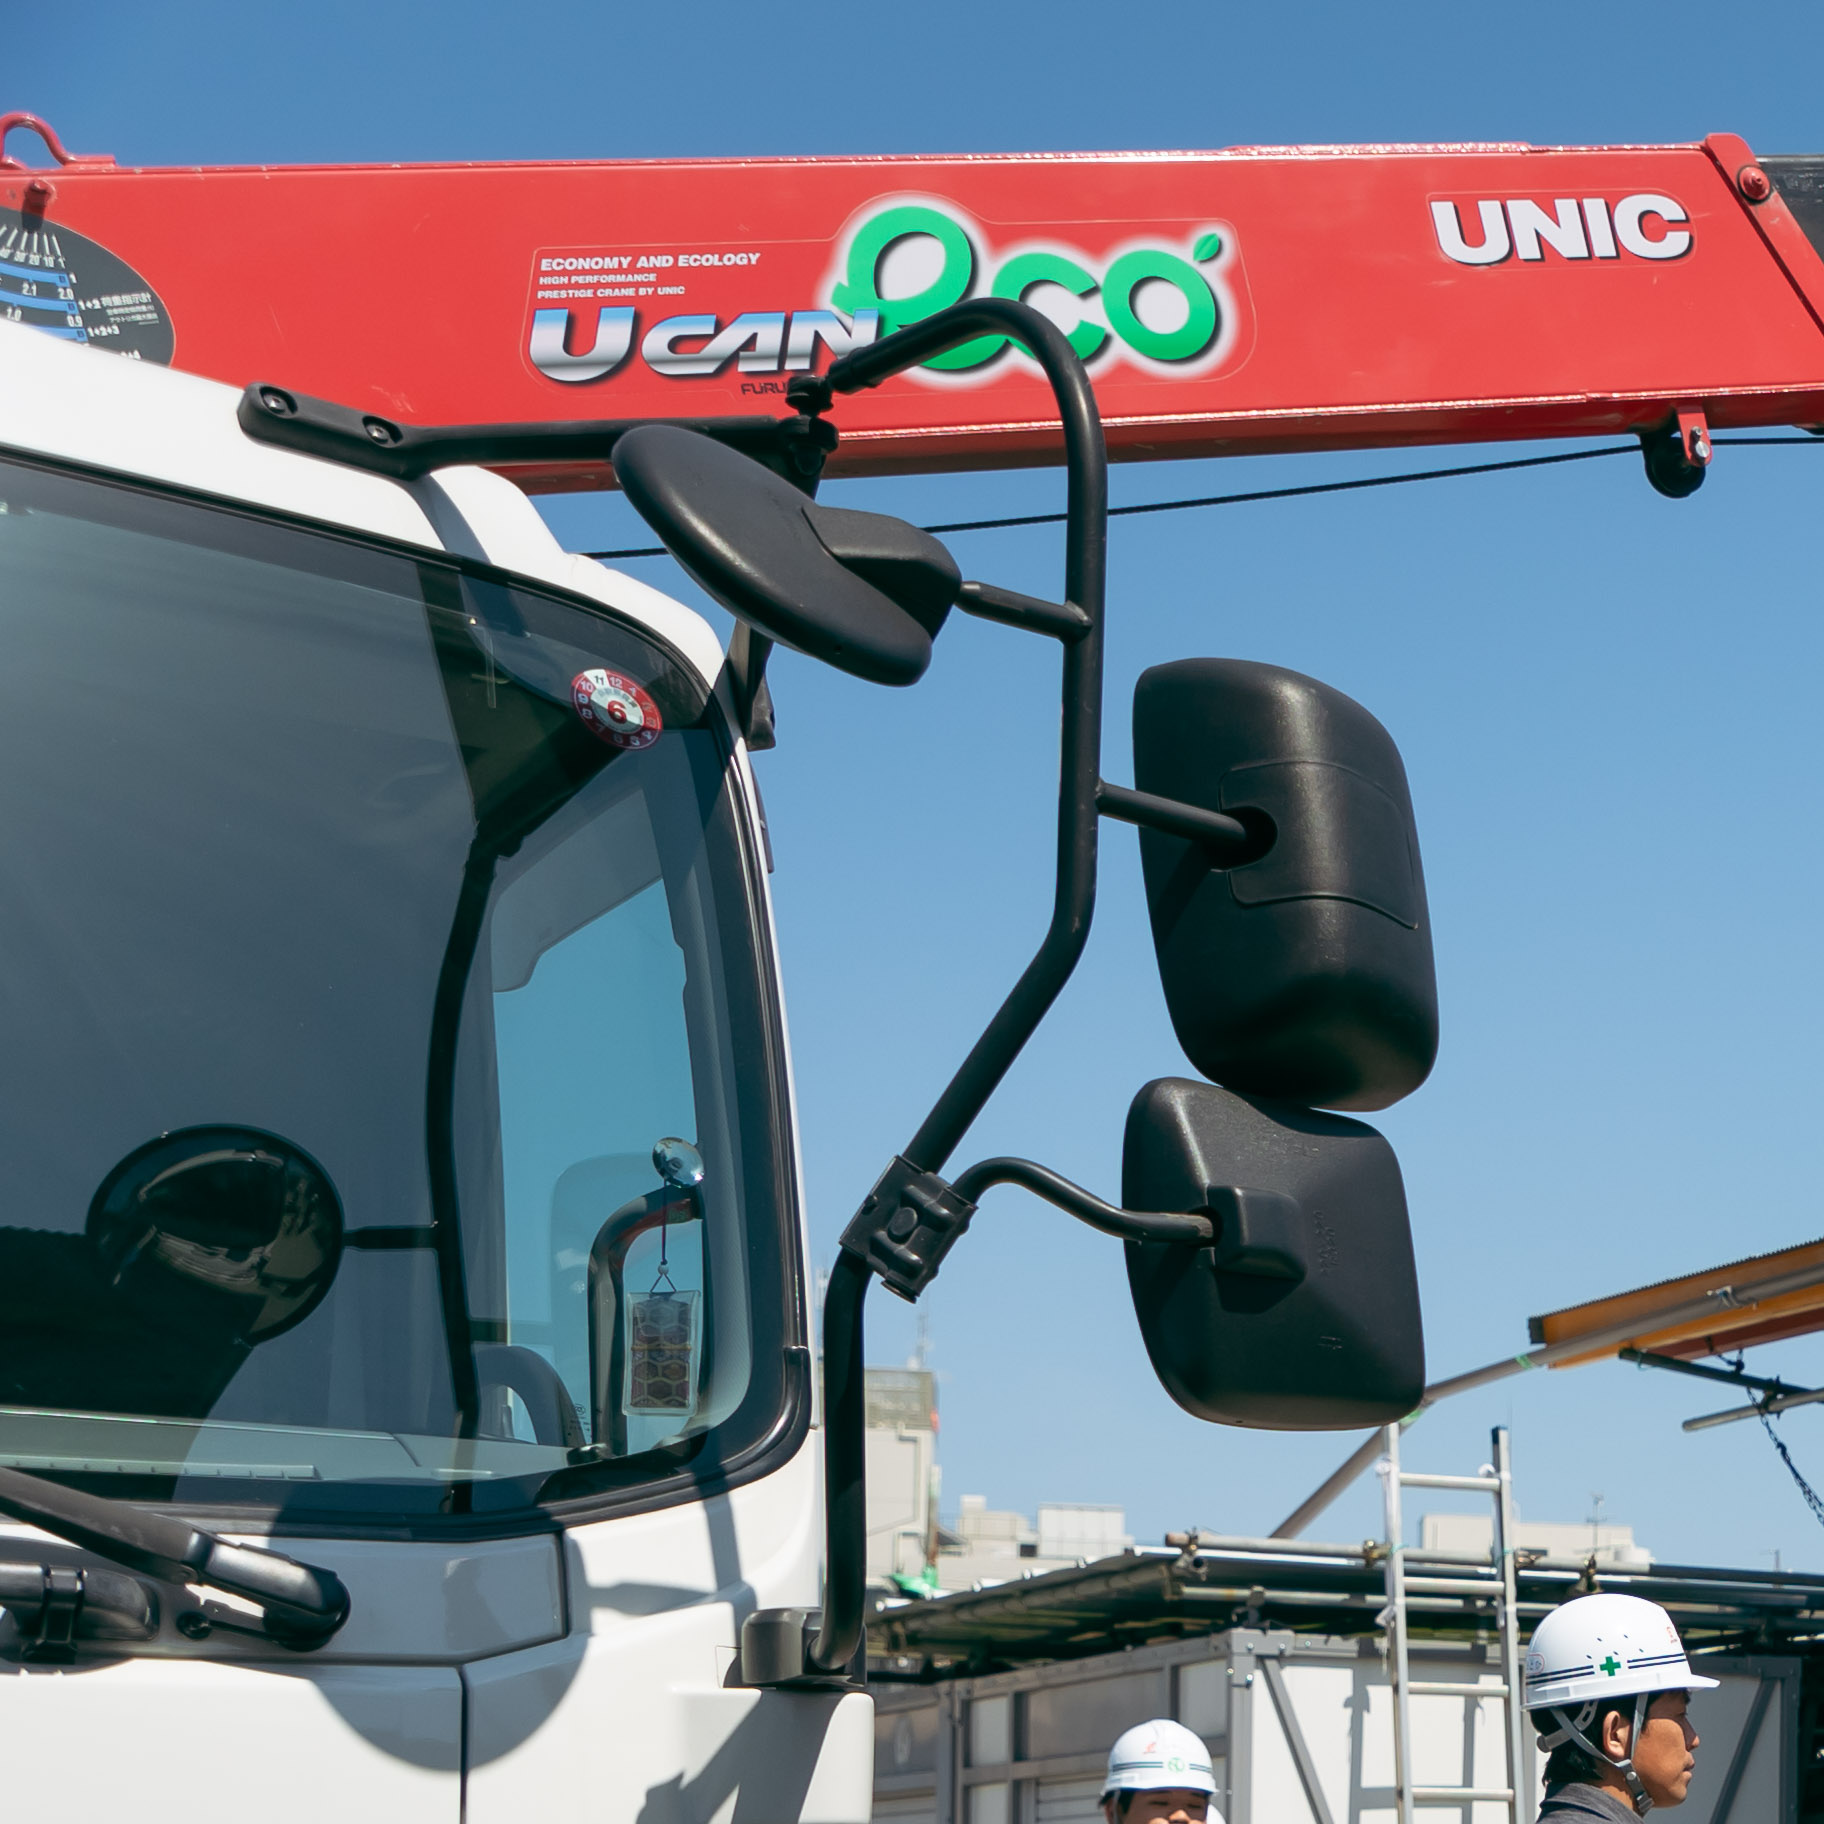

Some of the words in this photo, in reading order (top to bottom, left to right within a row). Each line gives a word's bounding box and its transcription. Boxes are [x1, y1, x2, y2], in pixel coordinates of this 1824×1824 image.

[1430, 193, 1693, 265] UNIC
[540, 256, 632, 271] ECONOMY
[636, 255, 674, 269] AND
[677, 253, 761, 267] ECOLOGY
[539, 275, 569, 285] HIGH
[570, 272, 657, 285] PERFORMANCE
[831, 205, 1219, 370] eco
[537, 288, 594, 299] PRESTIGE
[596, 286, 636, 297] CRANE
[638, 286, 655, 297] BY
[657, 285, 685, 296] UNIC
[607, 700, 628, 724] 6
